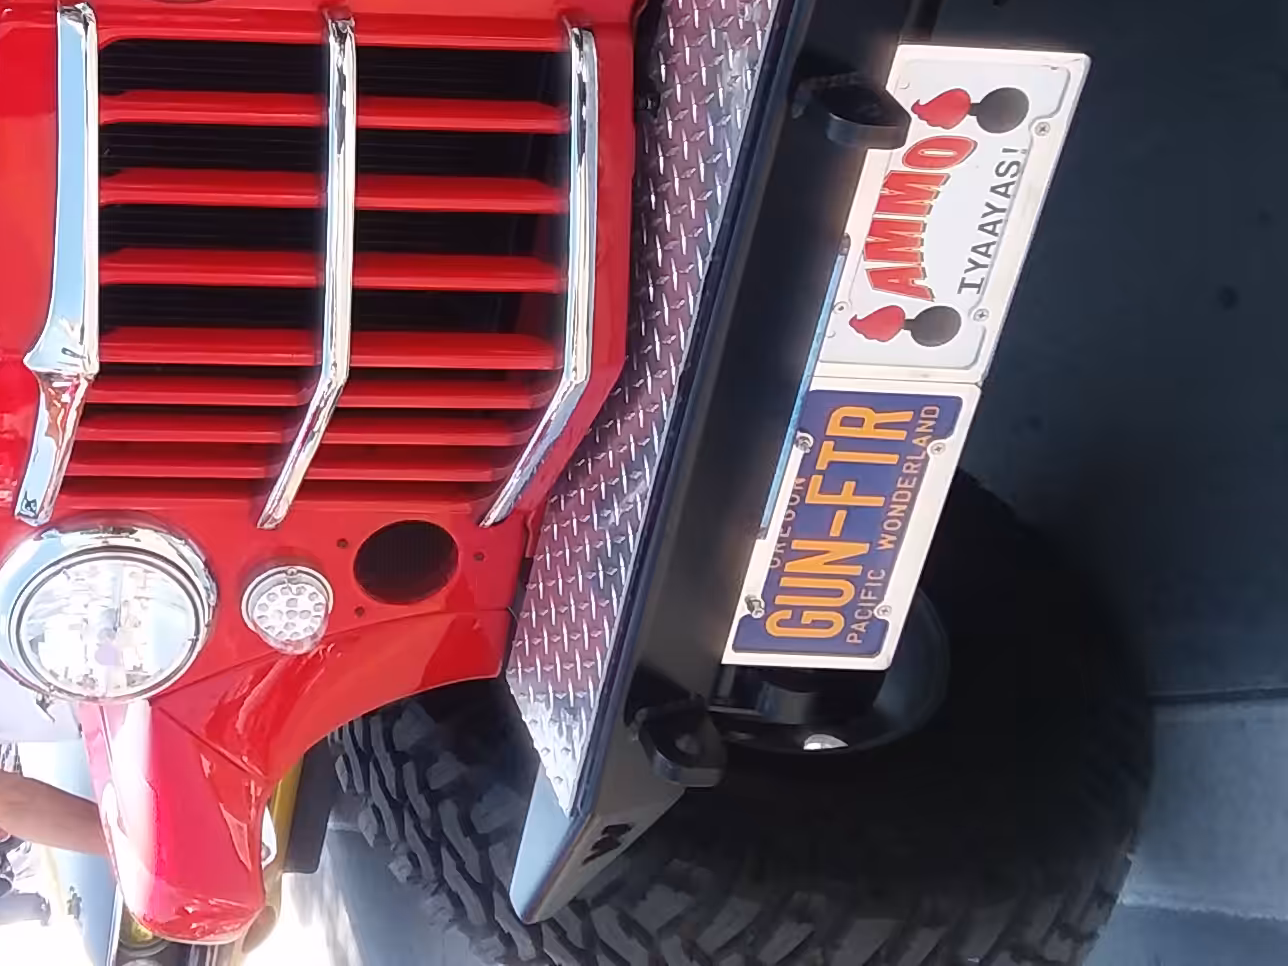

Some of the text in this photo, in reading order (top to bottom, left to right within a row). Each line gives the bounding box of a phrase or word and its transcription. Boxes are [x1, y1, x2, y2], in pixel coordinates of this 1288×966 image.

[863, 135, 978, 302] AMMO
[956, 147, 1029, 295] IYAAYAS!
[764, 405, 915, 639] GUN-FTR
[846, 405, 942, 644] PACIFIC WONDERLAND
